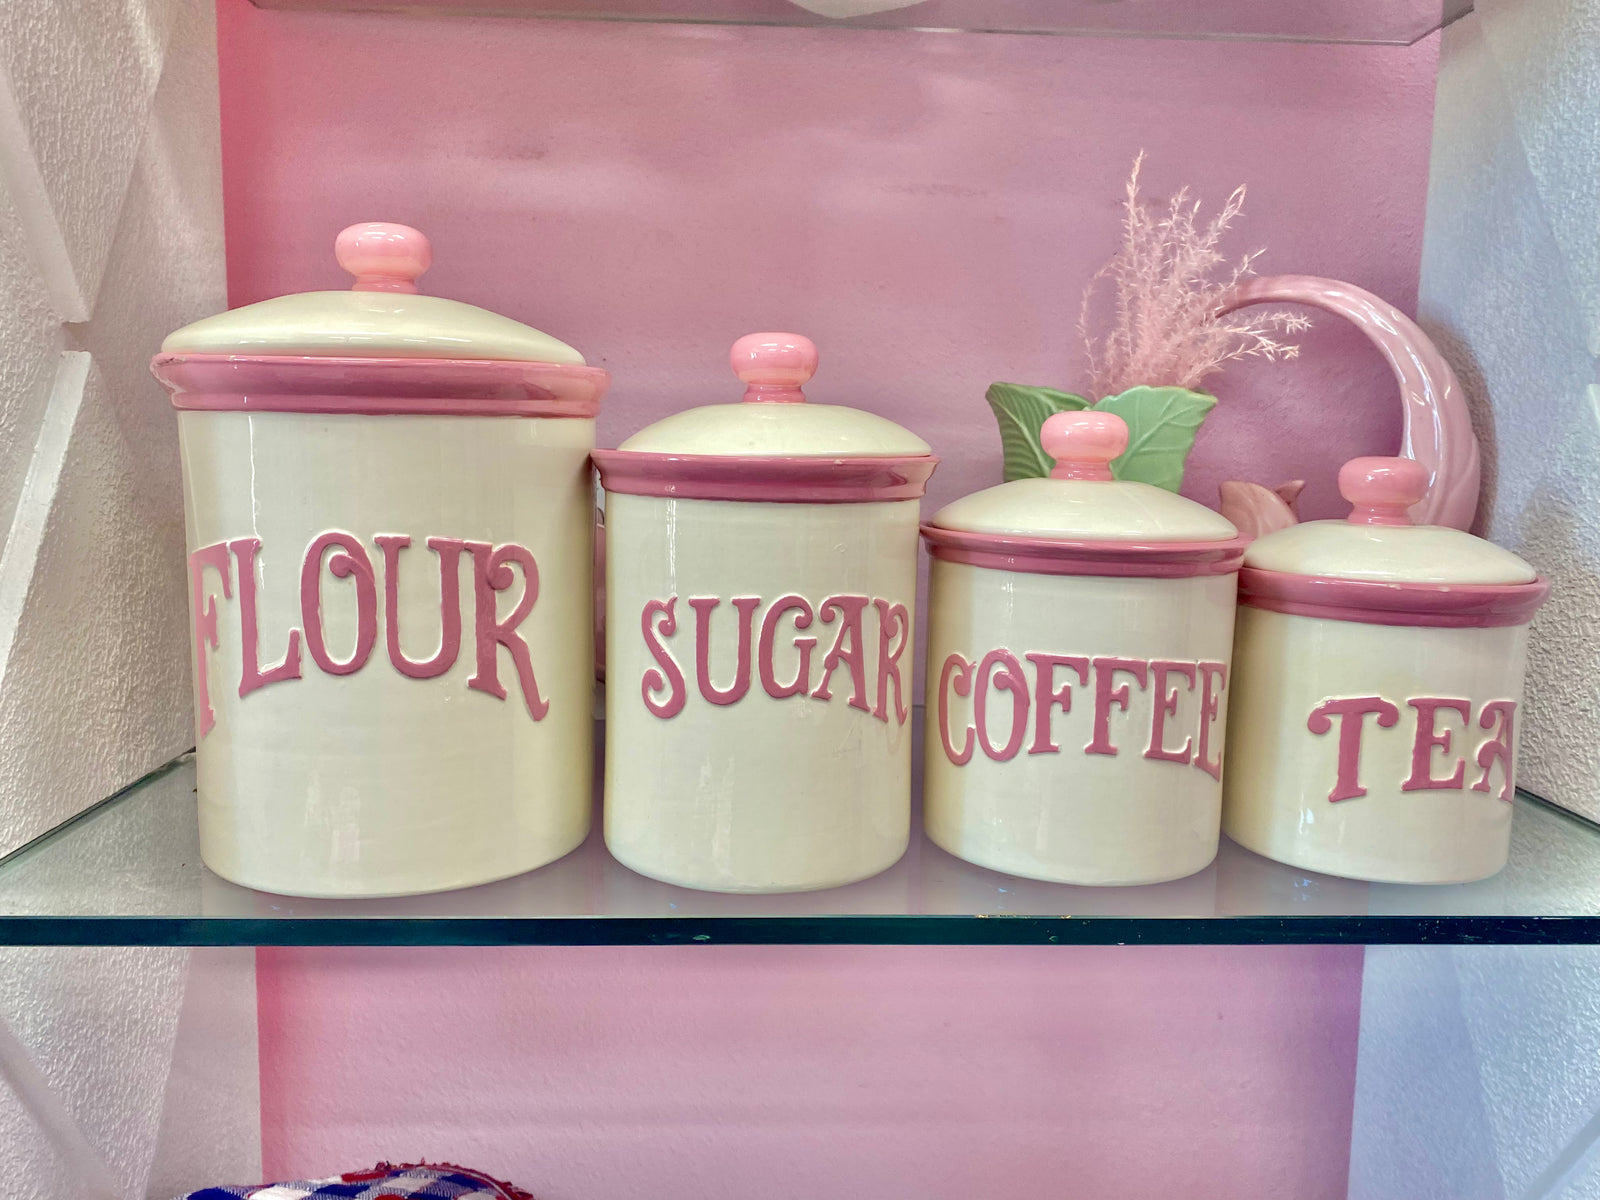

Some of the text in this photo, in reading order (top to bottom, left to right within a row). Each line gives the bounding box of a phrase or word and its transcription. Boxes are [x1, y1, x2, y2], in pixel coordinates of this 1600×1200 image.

[189, 531, 549, 739] FLOUR
[641, 595, 909, 725] SUGAR
[939, 648, 1227, 782] COFFEE
[1307, 696, 1517, 803] TEA
